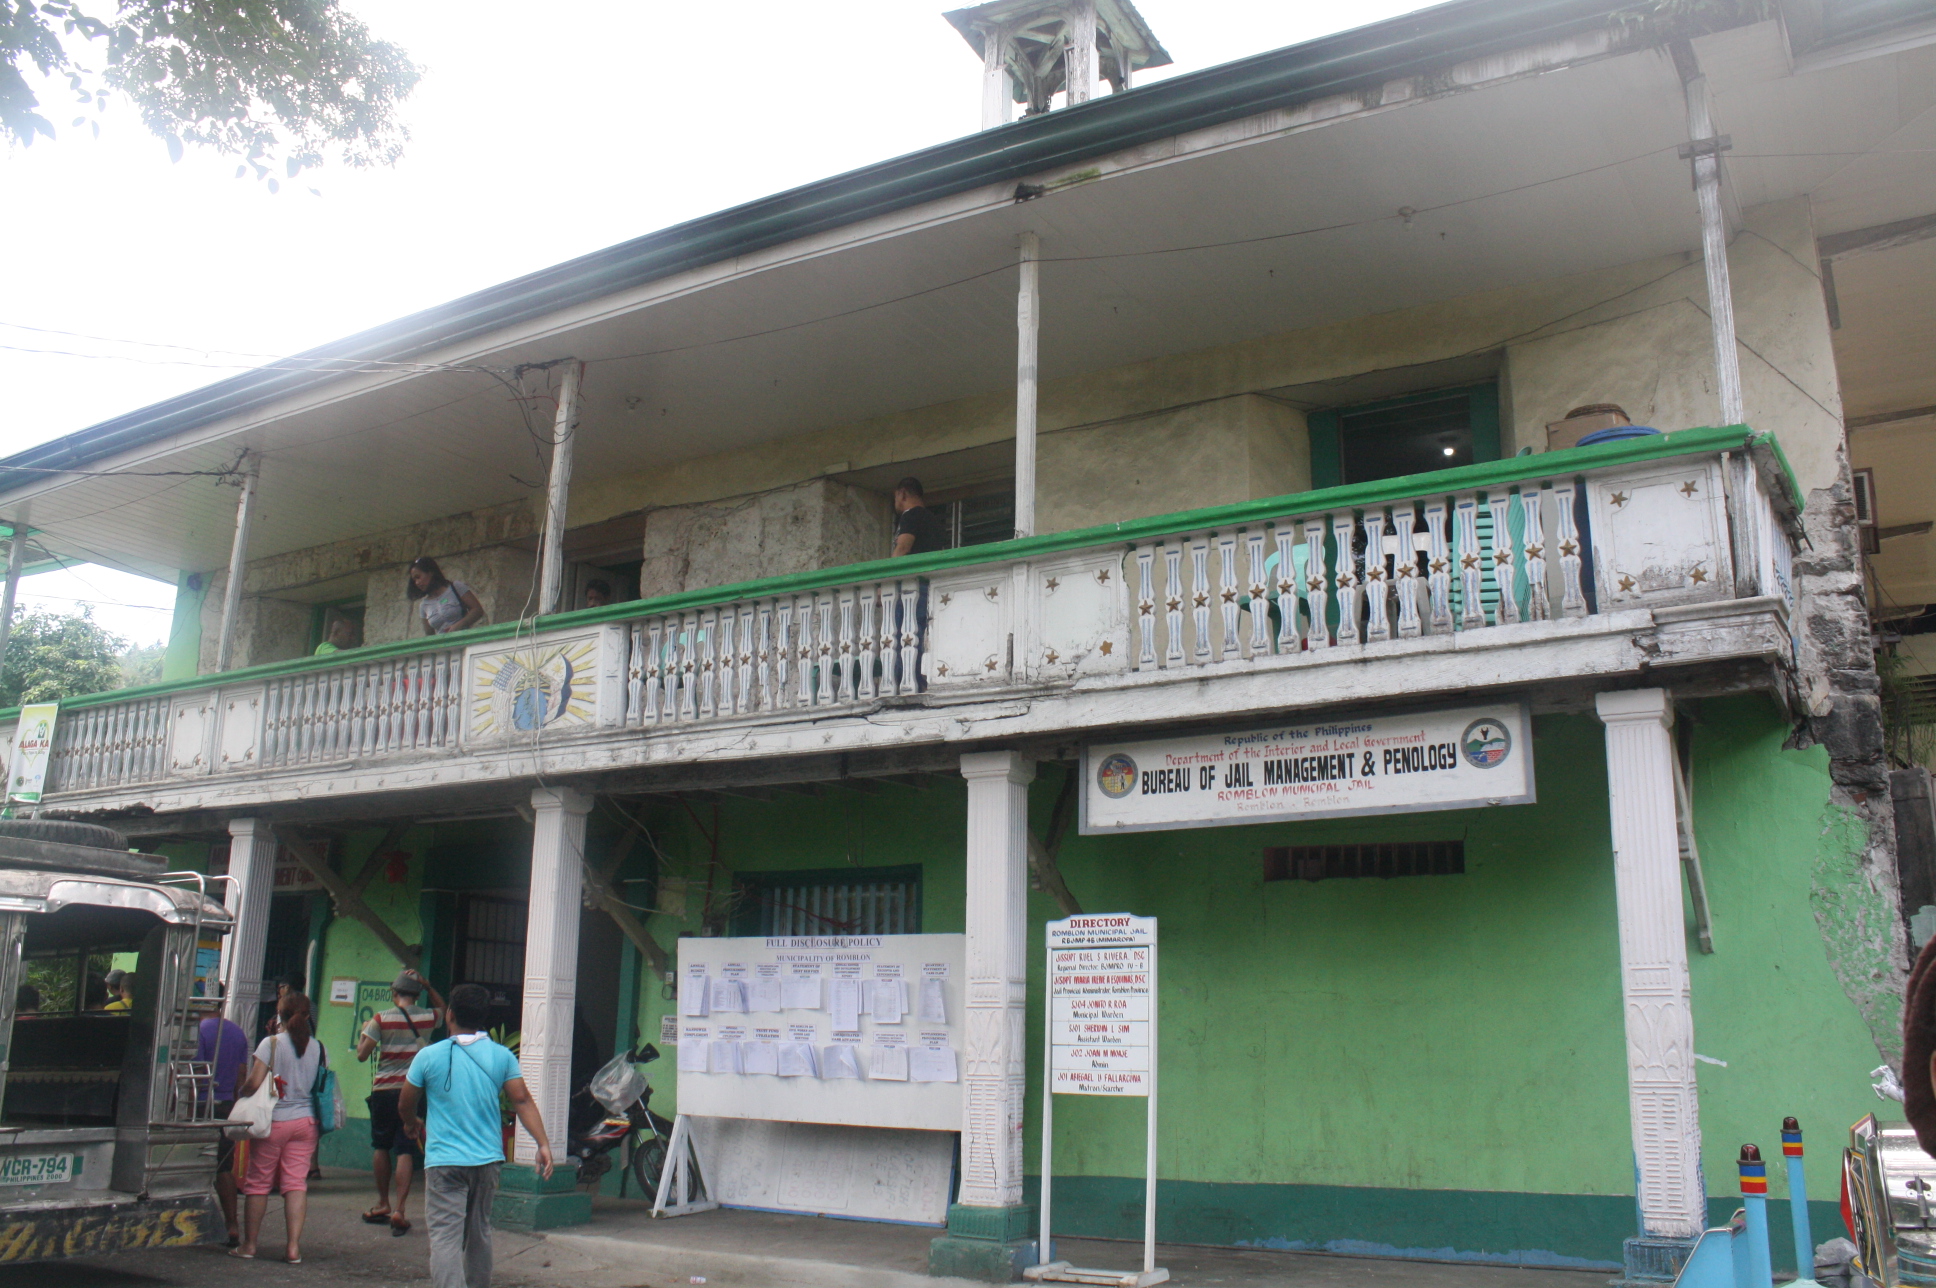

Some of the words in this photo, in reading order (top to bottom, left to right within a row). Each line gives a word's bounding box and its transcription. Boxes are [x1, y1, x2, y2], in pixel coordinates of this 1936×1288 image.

[1224, 733, 1268, 747] Republic
[1272, 731, 1286, 740] of
[1289, 730, 1309, 740] the
[1315, 723, 1372, 738] Philippines
[40, 739, 49, 748] KA
[1165, 750, 1225, 767] Department
[1229, 747, 1240, 761] of
[1243, 747, 1261, 759] the
[1264, 743, 1306, 758] Interior
[1310, 740, 1329, 753] and
[1334, 736, 1360, 752] Local
[1364, 729, 1427, 748] Government
[1142, 767, 1191, 796] BUREAU
[1200, 765, 1216, 791] OF
[1225, 762, 1254, 789] JAIL
[1263, 752, 1355, 786] MANAGEMENT
[1361, 751, 1376, 777] &
[1384, 742, 1457, 776] PENOLOGY
[1217, 786, 1278, 801] ROMBLON
[1282, 782, 1340, 797] MUNICIPAL
[1348, 779, 1376, 791] JAIL
[1070, 917, 1131, 928] DIRECTORY
[1052, 929, 1085, 937] ROMBLON
[1087, 928, 1127, 936] MUNICIPAL
[766, 939, 788, 948] FULL
[791, 937, 847, 948] DISCLOSURE
[848, 938, 883, 947] POLICY
[777, 954, 823, 962] MUNICIPALITY
[836, 953, 871, 961] ROMBLON
[1114, 1000, 1127, 1009] ROA
[1073, 1010, 1099, 1020] Municipal
[1102, 1010, 1124, 1019] Warden
[1077, 1034, 1100, 1043] Assistant
[1092, 1060, 1109, 1069] Admin
[5, 1175, 43, 1183] PHILIPPINES
